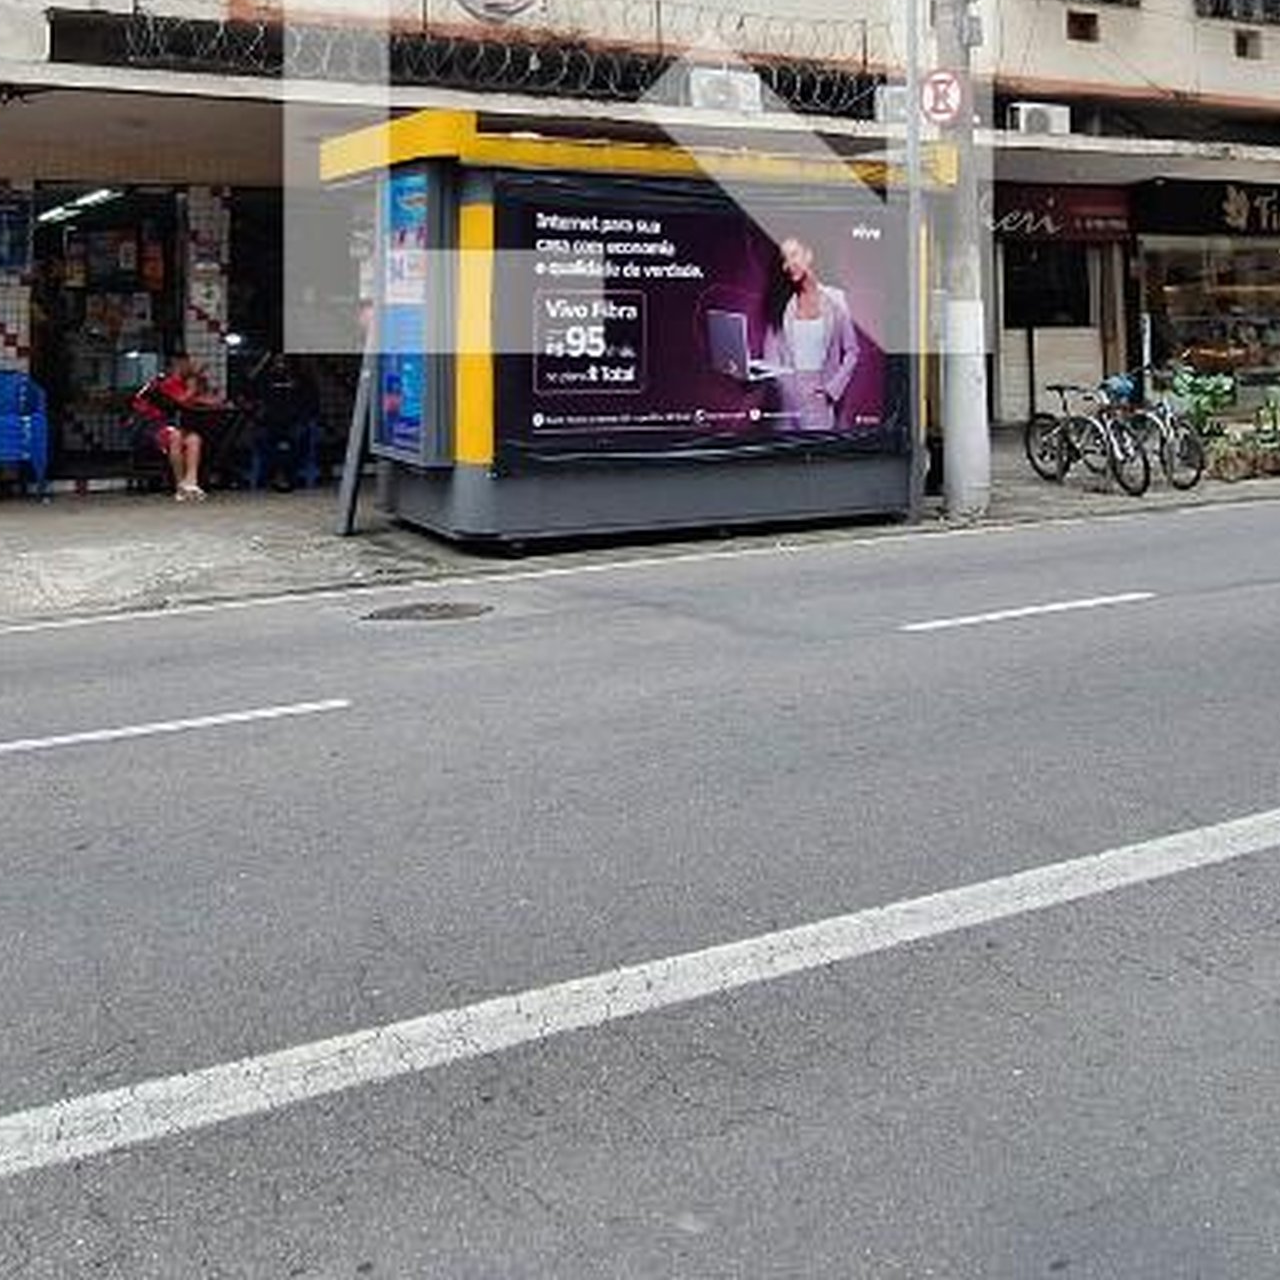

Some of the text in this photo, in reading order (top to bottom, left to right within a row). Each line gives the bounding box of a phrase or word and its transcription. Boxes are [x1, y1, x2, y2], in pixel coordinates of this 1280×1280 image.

[536, 213, 599, 231] Internet
[601, 219, 634, 233] para
[536, 239, 569, 253] casa
[606, 240, 675, 256] economia
[549, 259, 620, 278] qualidade
[545, 299, 588, 319] Vivo
[566, 325, 606, 357] 95
